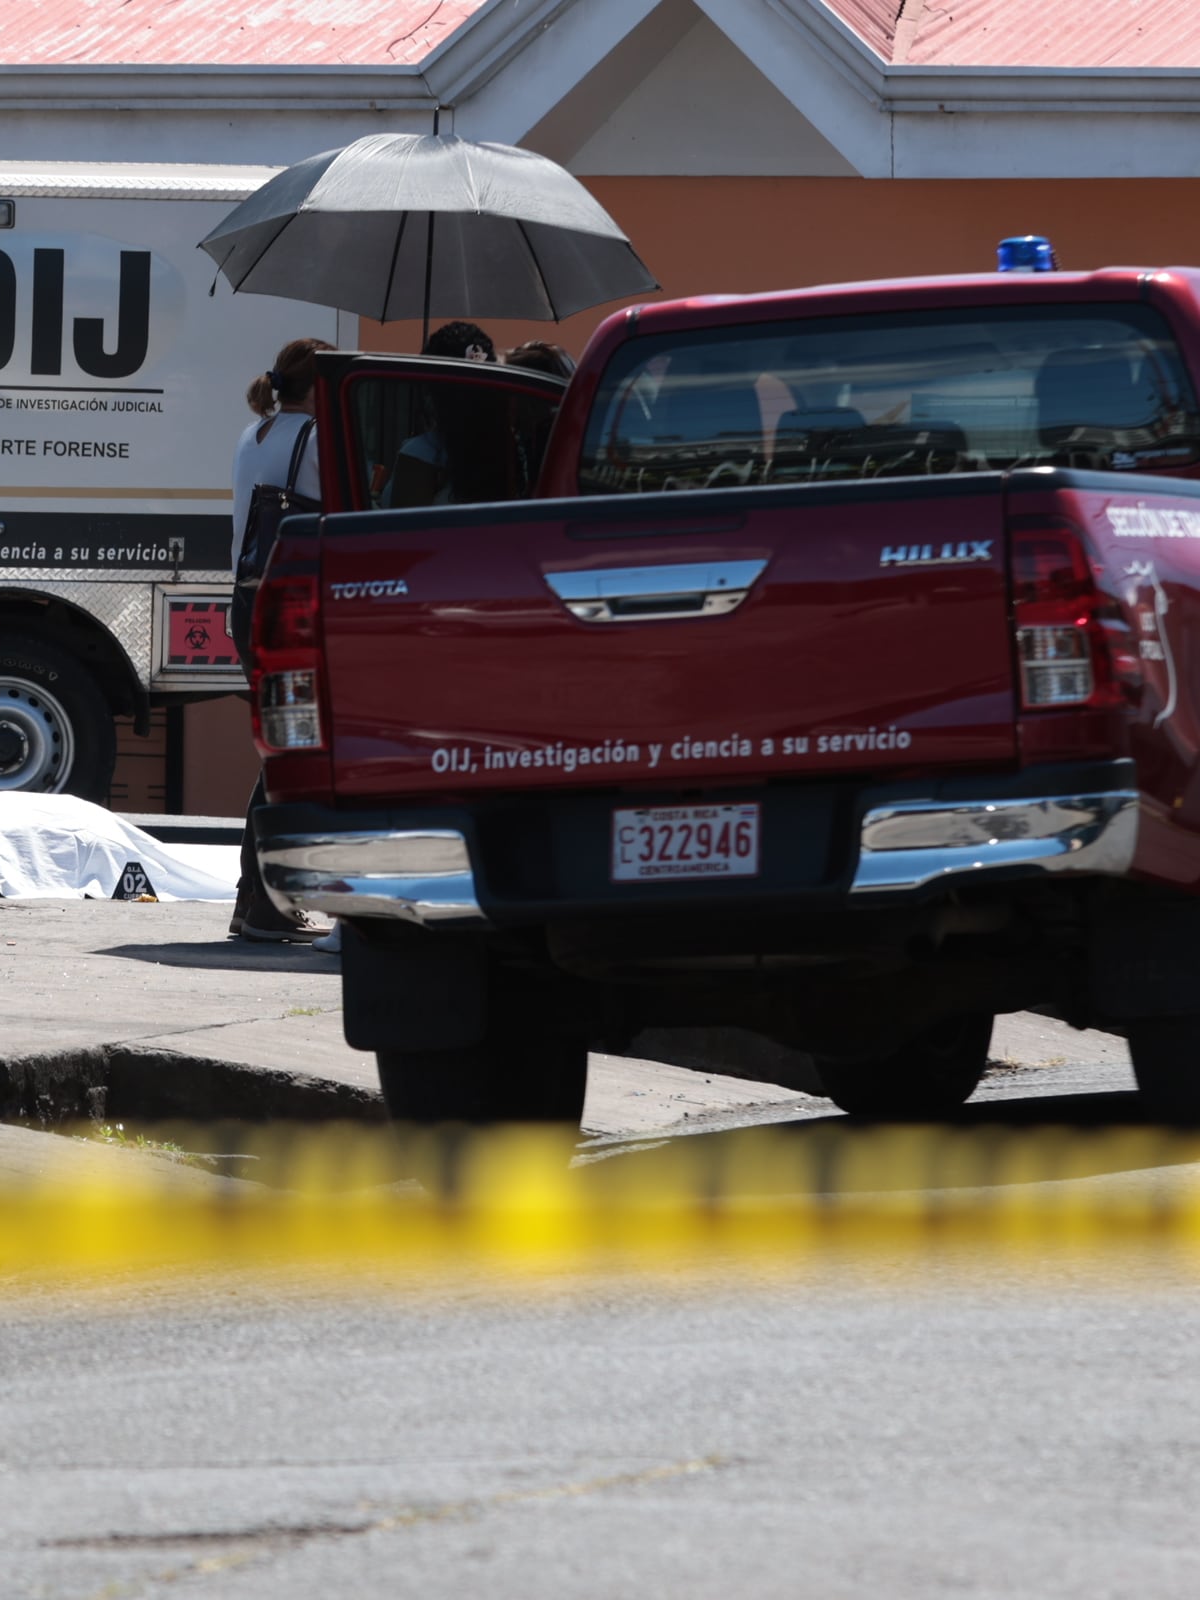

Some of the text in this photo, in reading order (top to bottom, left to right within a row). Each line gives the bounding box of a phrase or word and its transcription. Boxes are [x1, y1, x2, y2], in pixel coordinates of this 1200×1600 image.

[16, 397, 109, 412] INVESTIGACIÓN
[111, 399, 164, 413] JUDICIAL
[43, 440, 130, 458] FORENSE
[54, 547, 64, 560] a
[70, 547, 90, 560] su
[98, 544, 167, 561] servicio
[880, 539, 994, 567] HILUX
[331, 578, 409, 601] TOYOTA
[431, 726, 911, 774] OIJ, investigación y ciencia a su servicio
[653, 808, 719, 821] COSTA RICA
[638, 821, 752, 861] 322946
[639, 863, 731, 875] CENTROAMERICA
[123, 873, 147, 893] 02
